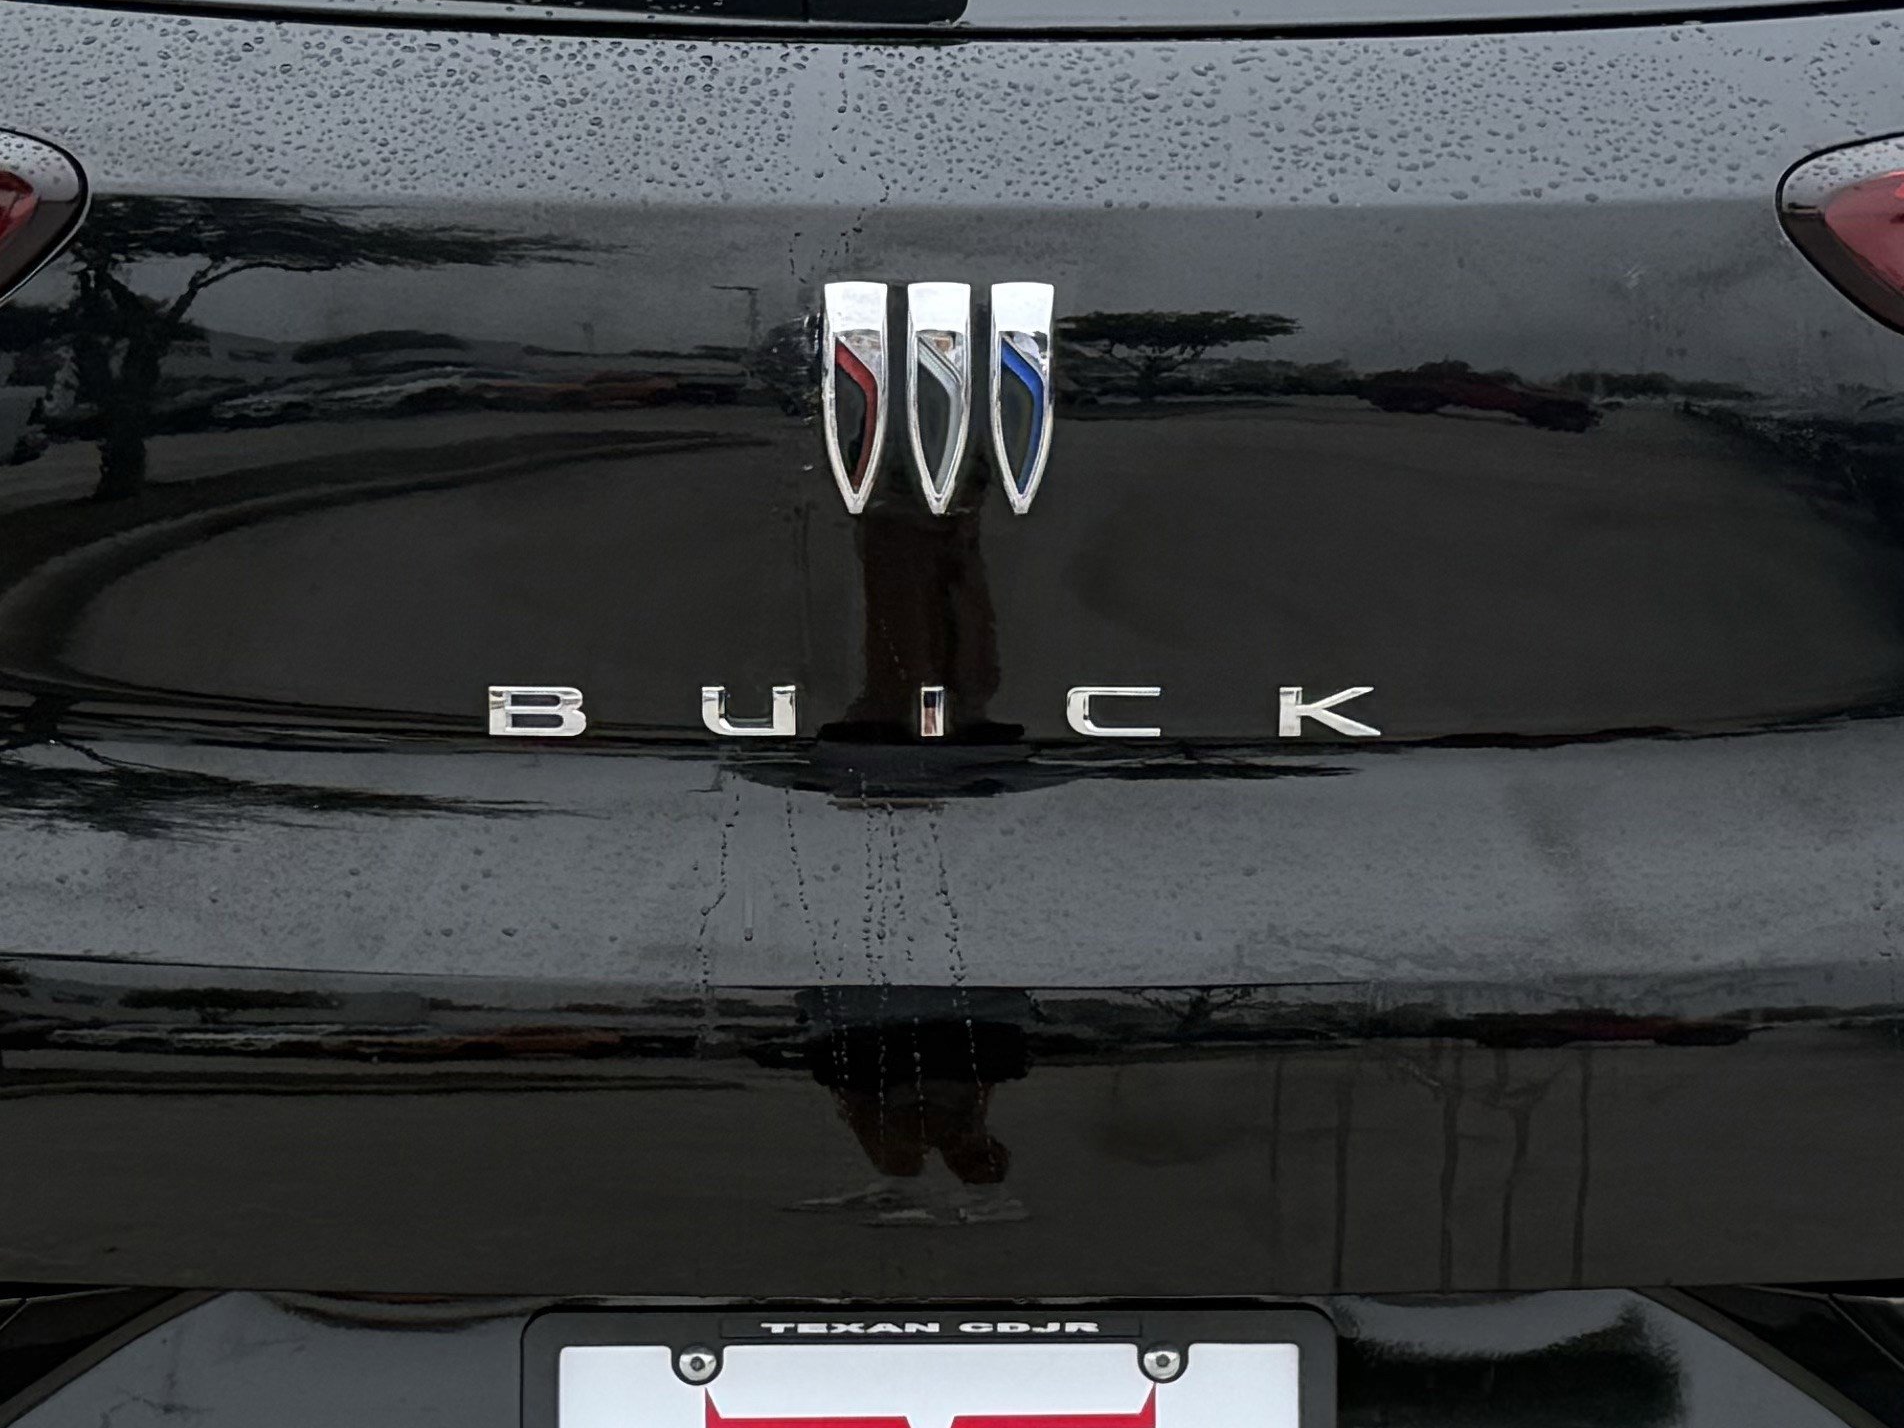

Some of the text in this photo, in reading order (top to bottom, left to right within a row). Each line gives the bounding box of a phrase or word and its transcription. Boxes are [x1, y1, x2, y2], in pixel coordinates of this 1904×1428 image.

[488, 684, 1382, 738] BUICK
[760, 1321, 1100, 1334] TEXAN CDJR
